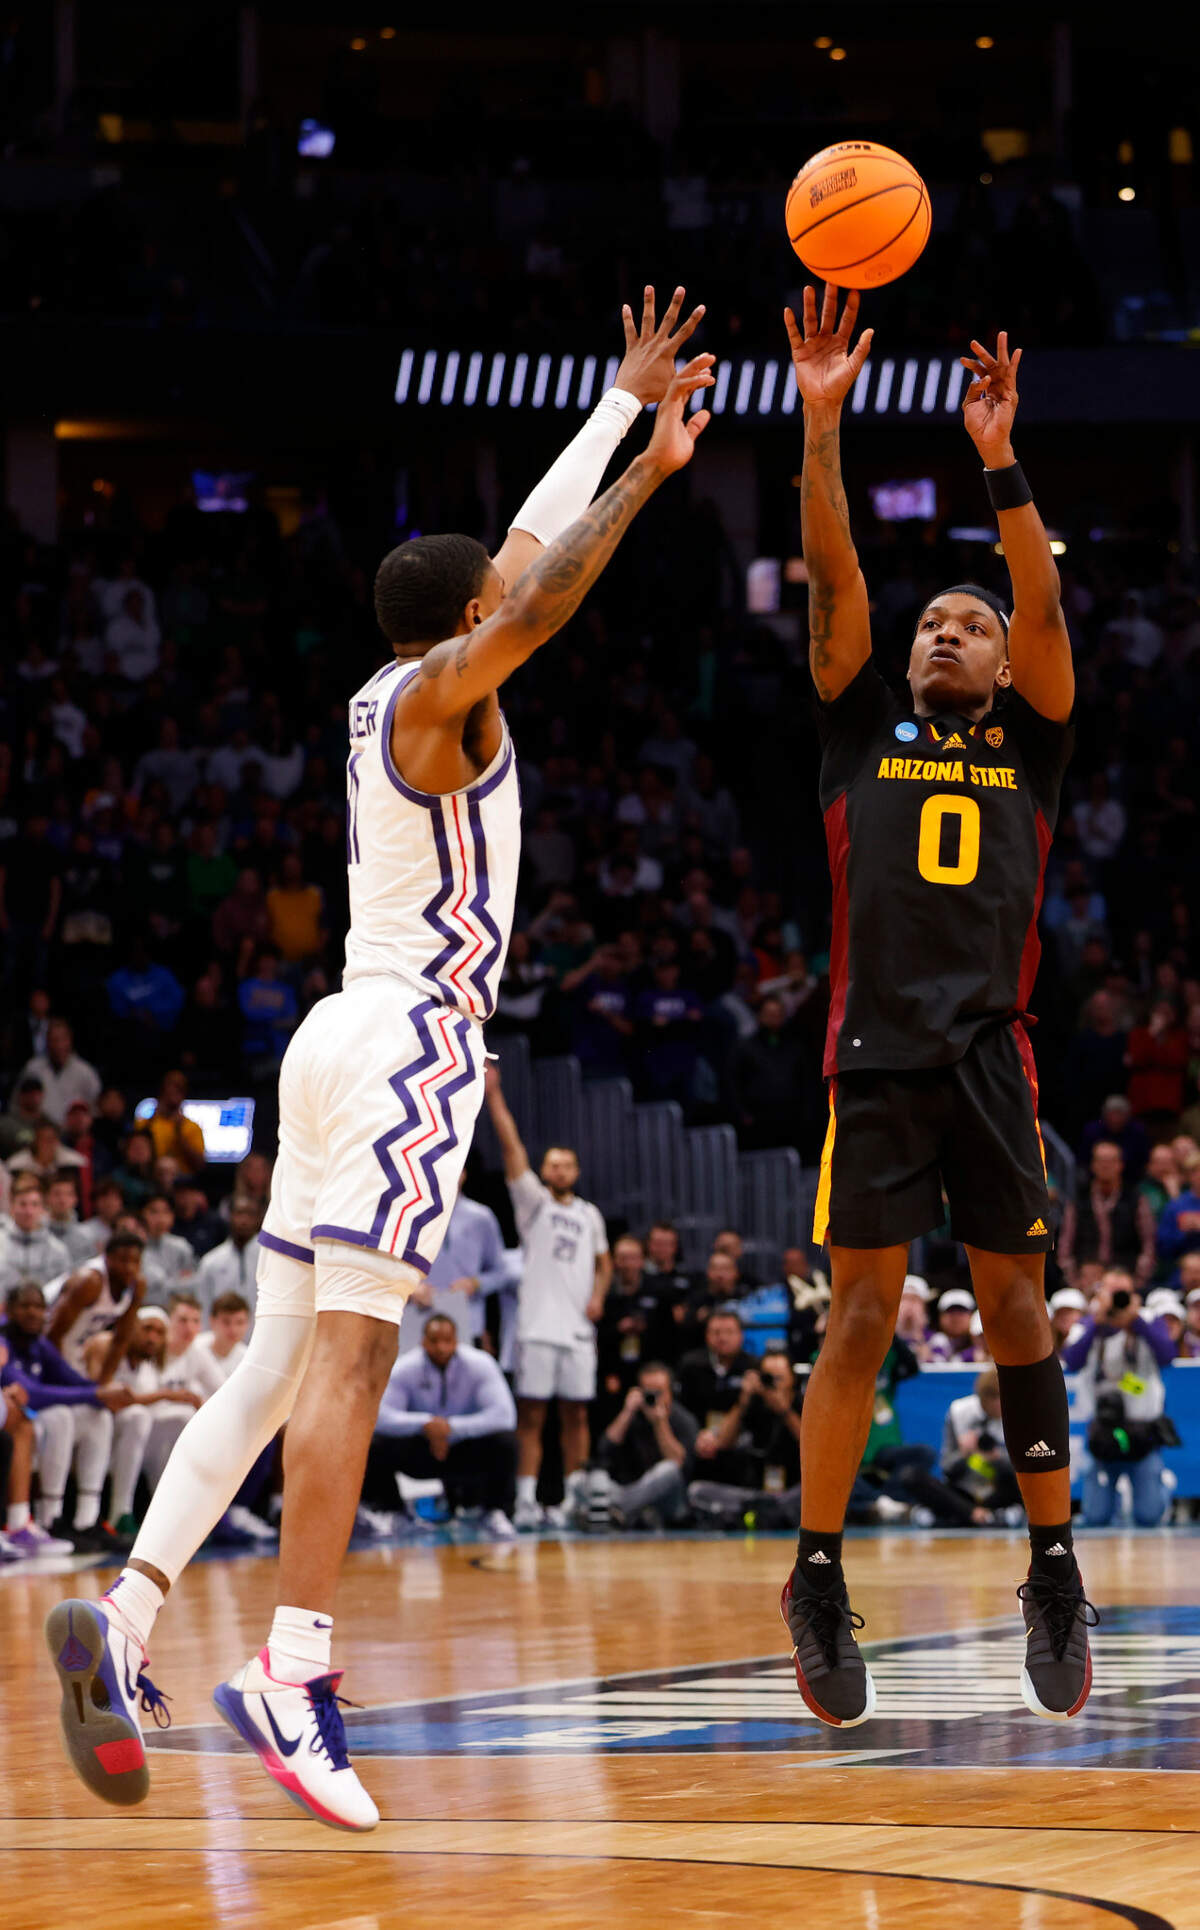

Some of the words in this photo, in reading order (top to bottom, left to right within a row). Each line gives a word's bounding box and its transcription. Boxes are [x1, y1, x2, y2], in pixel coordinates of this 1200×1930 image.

[942, 742, 967, 750] adidas
[877, 757, 965, 782] ARIZONA
[969, 764, 1018, 790] STATE
[918, 794, 980, 886] 0
[1026, 1229, 1048, 1237] adidas
[1025, 1449, 1056, 1457] adidas
